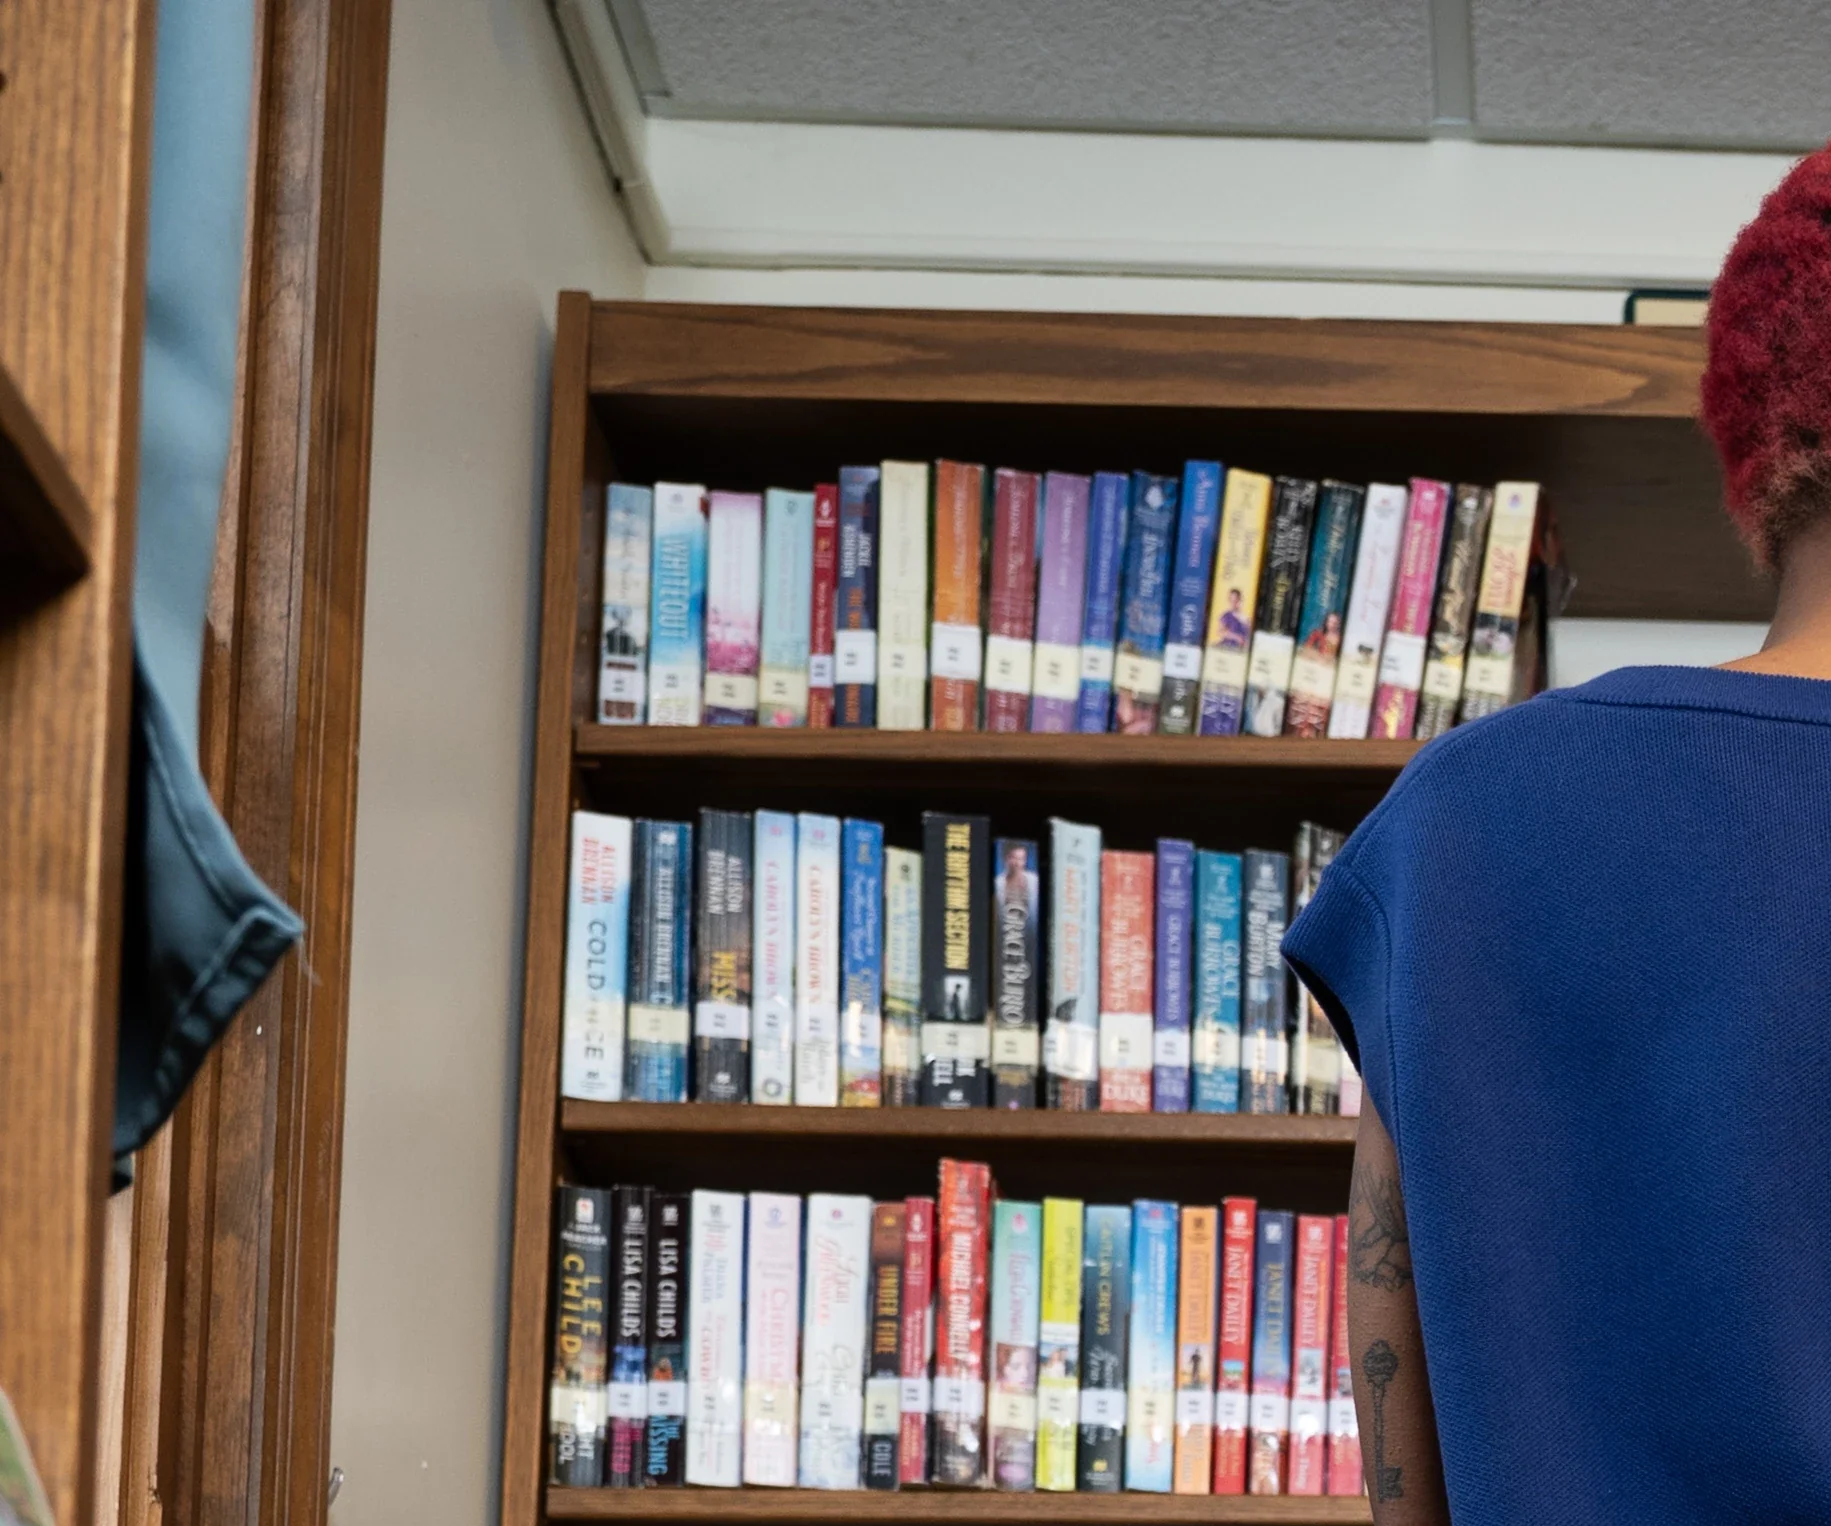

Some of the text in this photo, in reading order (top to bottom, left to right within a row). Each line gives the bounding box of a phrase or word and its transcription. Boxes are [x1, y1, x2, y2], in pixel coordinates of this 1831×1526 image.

[707, 850, 725, 915] BRENNAN
[727, 856, 742, 913] ALLISON
[945, 823, 970, 970] THE RHYTHM SECTION
[586, 920, 607, 991] COLD
[561, 1254, 584, 1355] CHILD
[621, 1238, 642, 1338] LISA CHILDS
[659, 1238, 678, 1338] LISA CHILDS
[877, 1264, 898, 1355] UNDER FIRE
